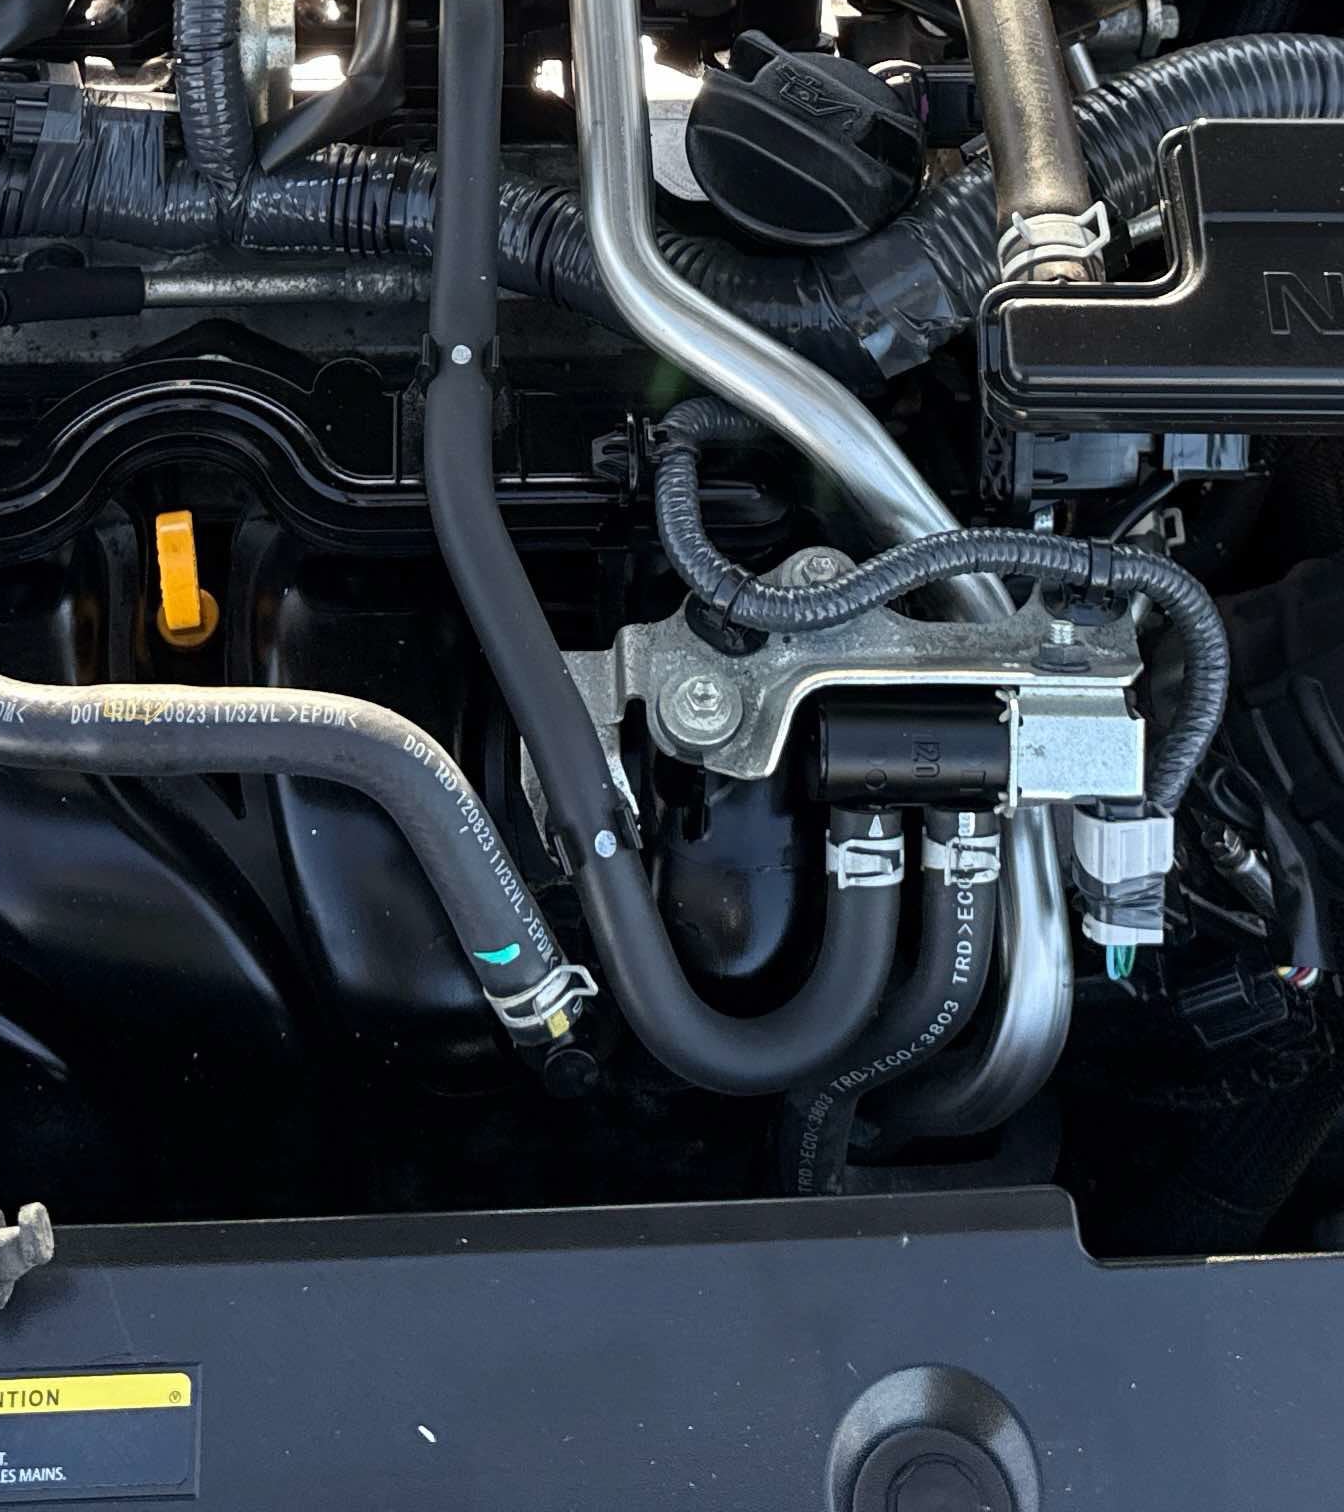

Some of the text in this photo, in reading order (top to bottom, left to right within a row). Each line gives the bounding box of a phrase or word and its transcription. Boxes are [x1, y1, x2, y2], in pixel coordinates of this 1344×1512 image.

[71, 703, 102, 725] DOT
[144, 702, 206, 725] 120823
[213, 703, 280, 724] 11/32VL
[403, 734, 435, 766] DOT
[456, 790, 495, 852] 120823
[489, 849, 524, 914] 11/32VL
[19, 1467, 66, 1483] MAINS.
